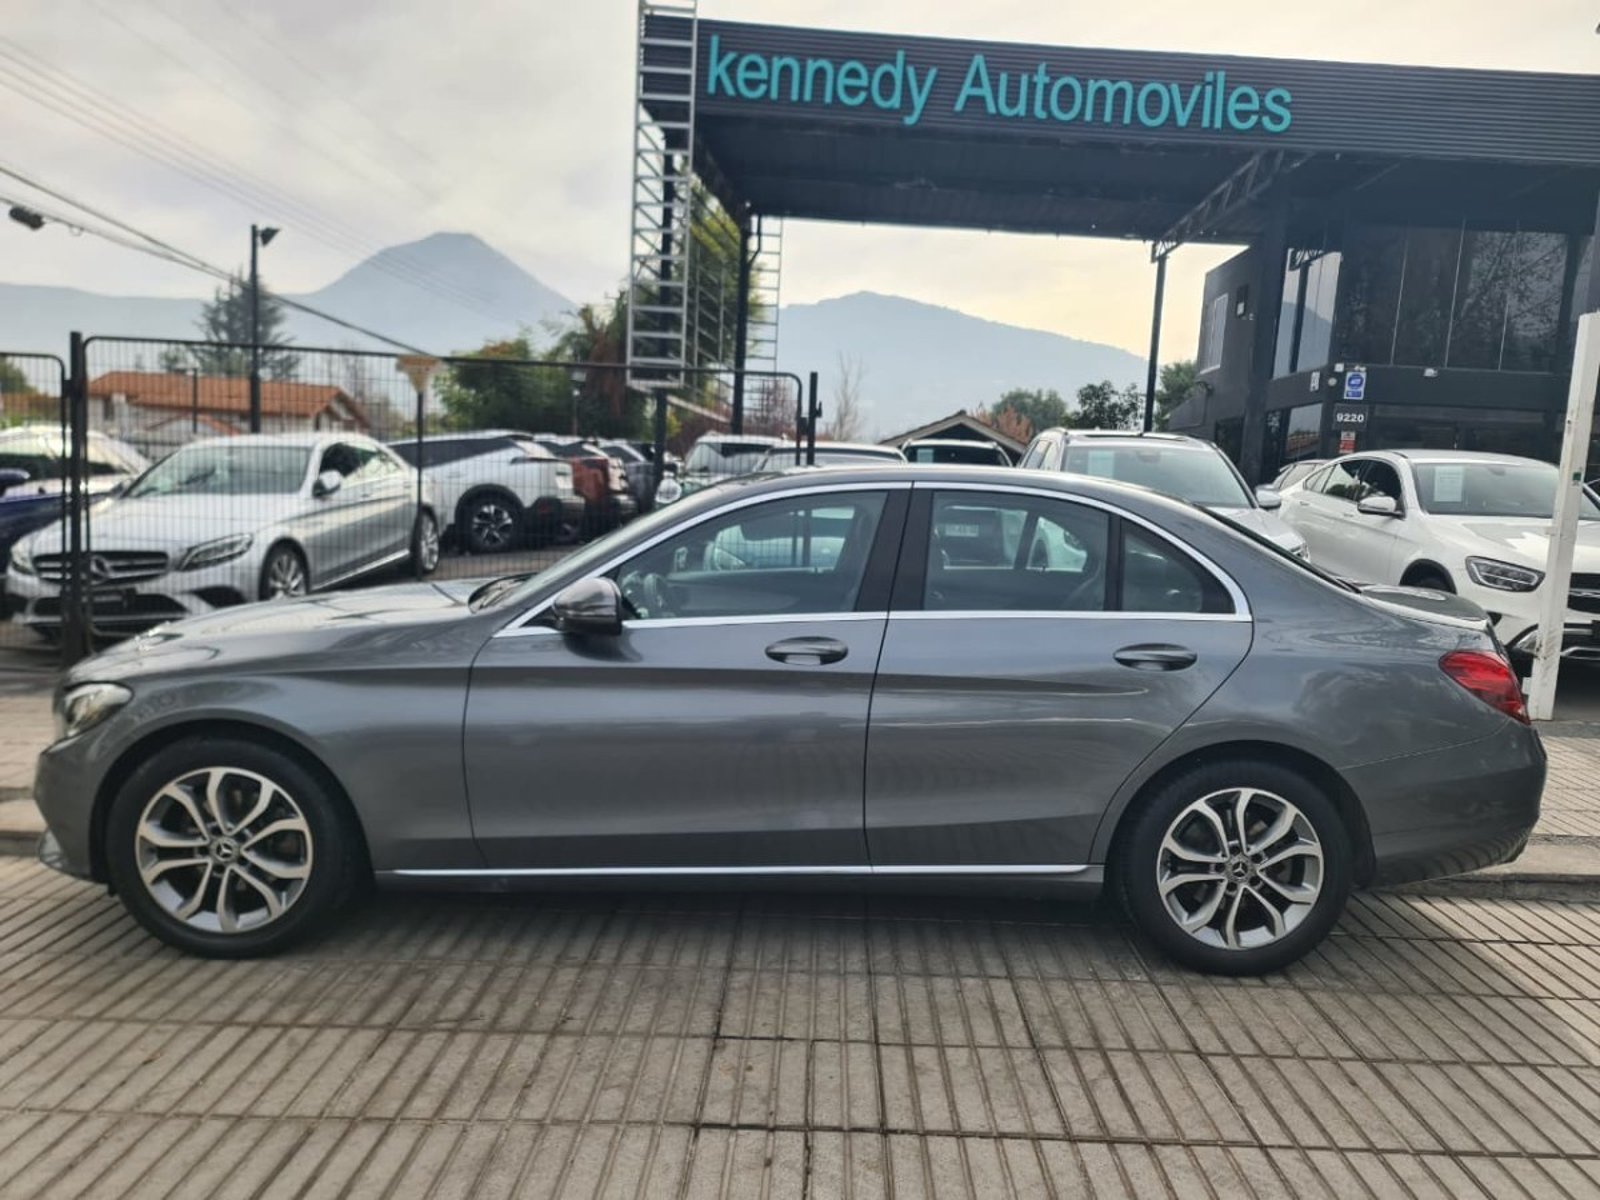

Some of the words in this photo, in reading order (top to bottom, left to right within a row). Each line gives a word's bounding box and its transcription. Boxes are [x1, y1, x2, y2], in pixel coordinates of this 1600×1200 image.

[707, 35, 937, 126] kennedy
[954, 54, 1293, 133] Automoviles
[1336, 413, 1365, 422] 9220
